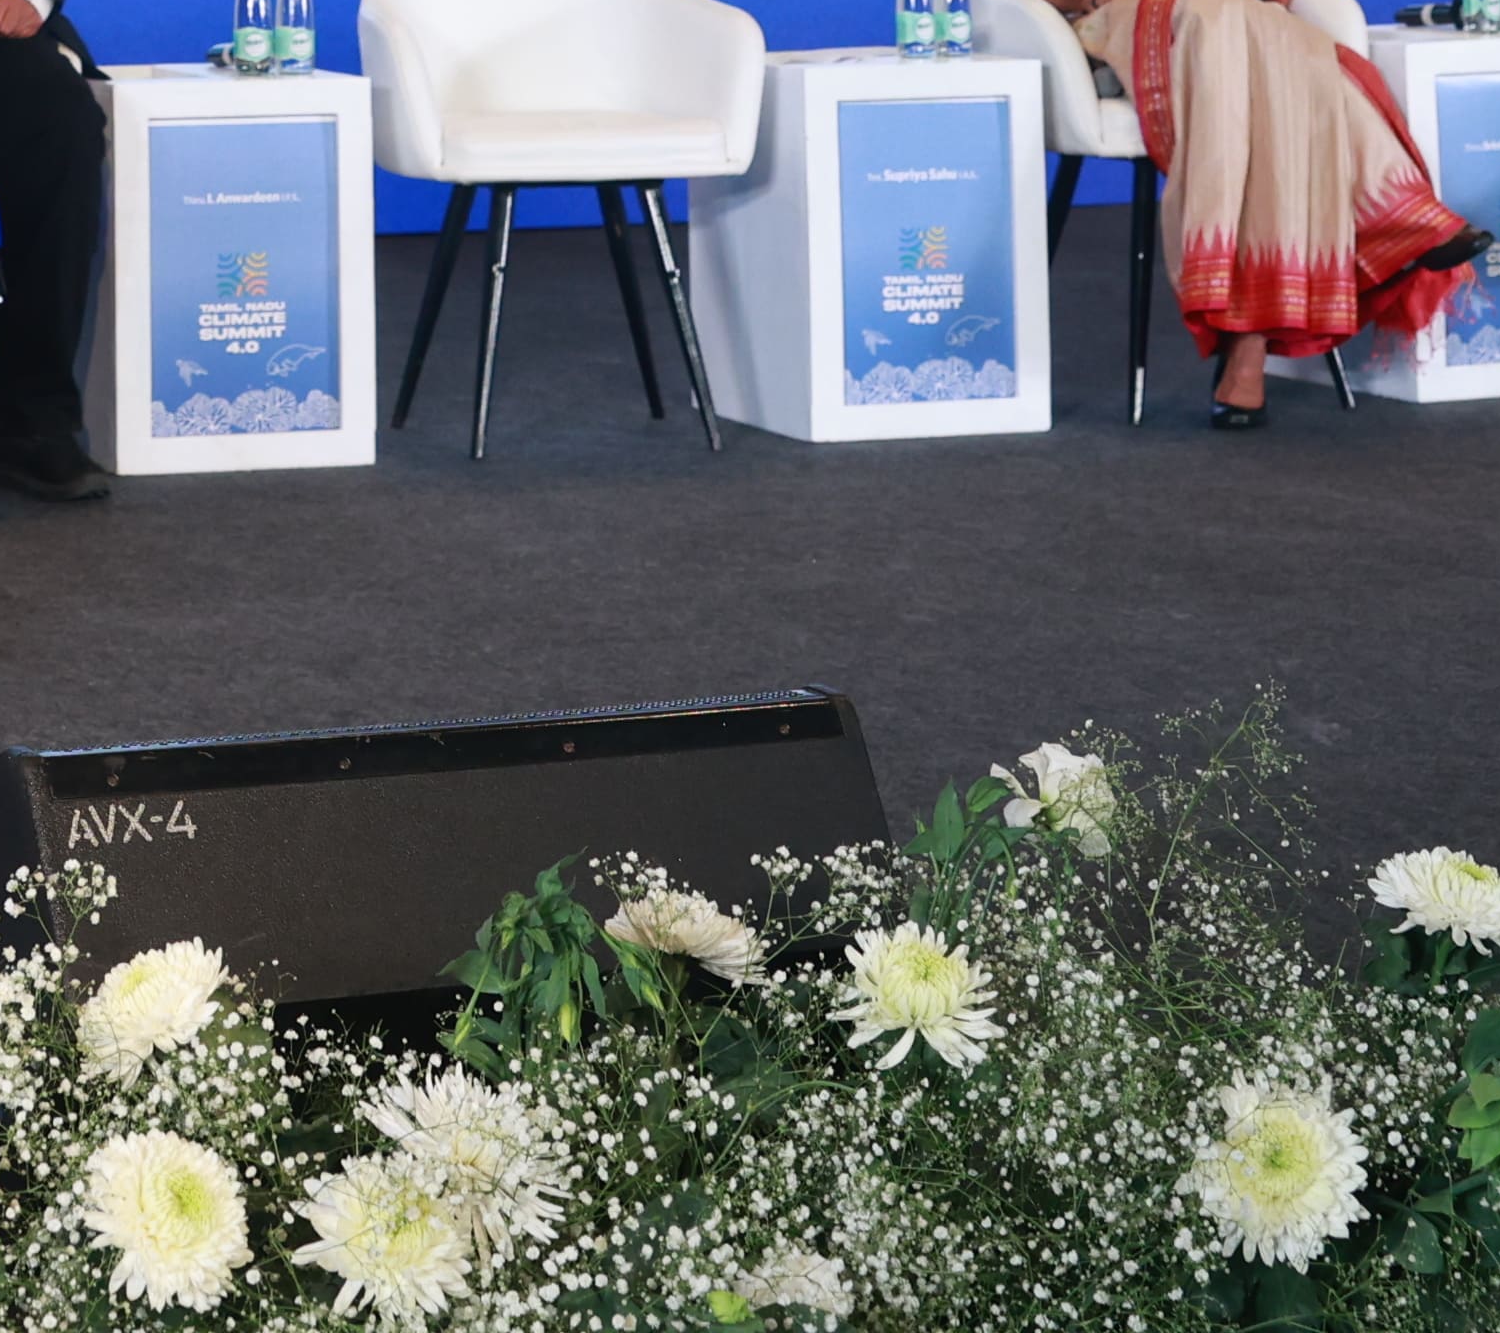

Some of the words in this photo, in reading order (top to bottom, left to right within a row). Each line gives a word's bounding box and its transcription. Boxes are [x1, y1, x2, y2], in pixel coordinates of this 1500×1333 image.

[882, 283, 964, 299] CLIMATE
[199, 303, 243, 314] TAMIL
[245, 301, 287, 312] NADU
[882, 297, 964, 312] SUMMIT
[199, 311, 287, 328] CLIMATE
[907, 311, 940, 326] 4.0
[199, 325, 287, 342] SUMMIT
[225, 340, 261, 355] 4.0
[67, 799, 199, 850] AVX-4
